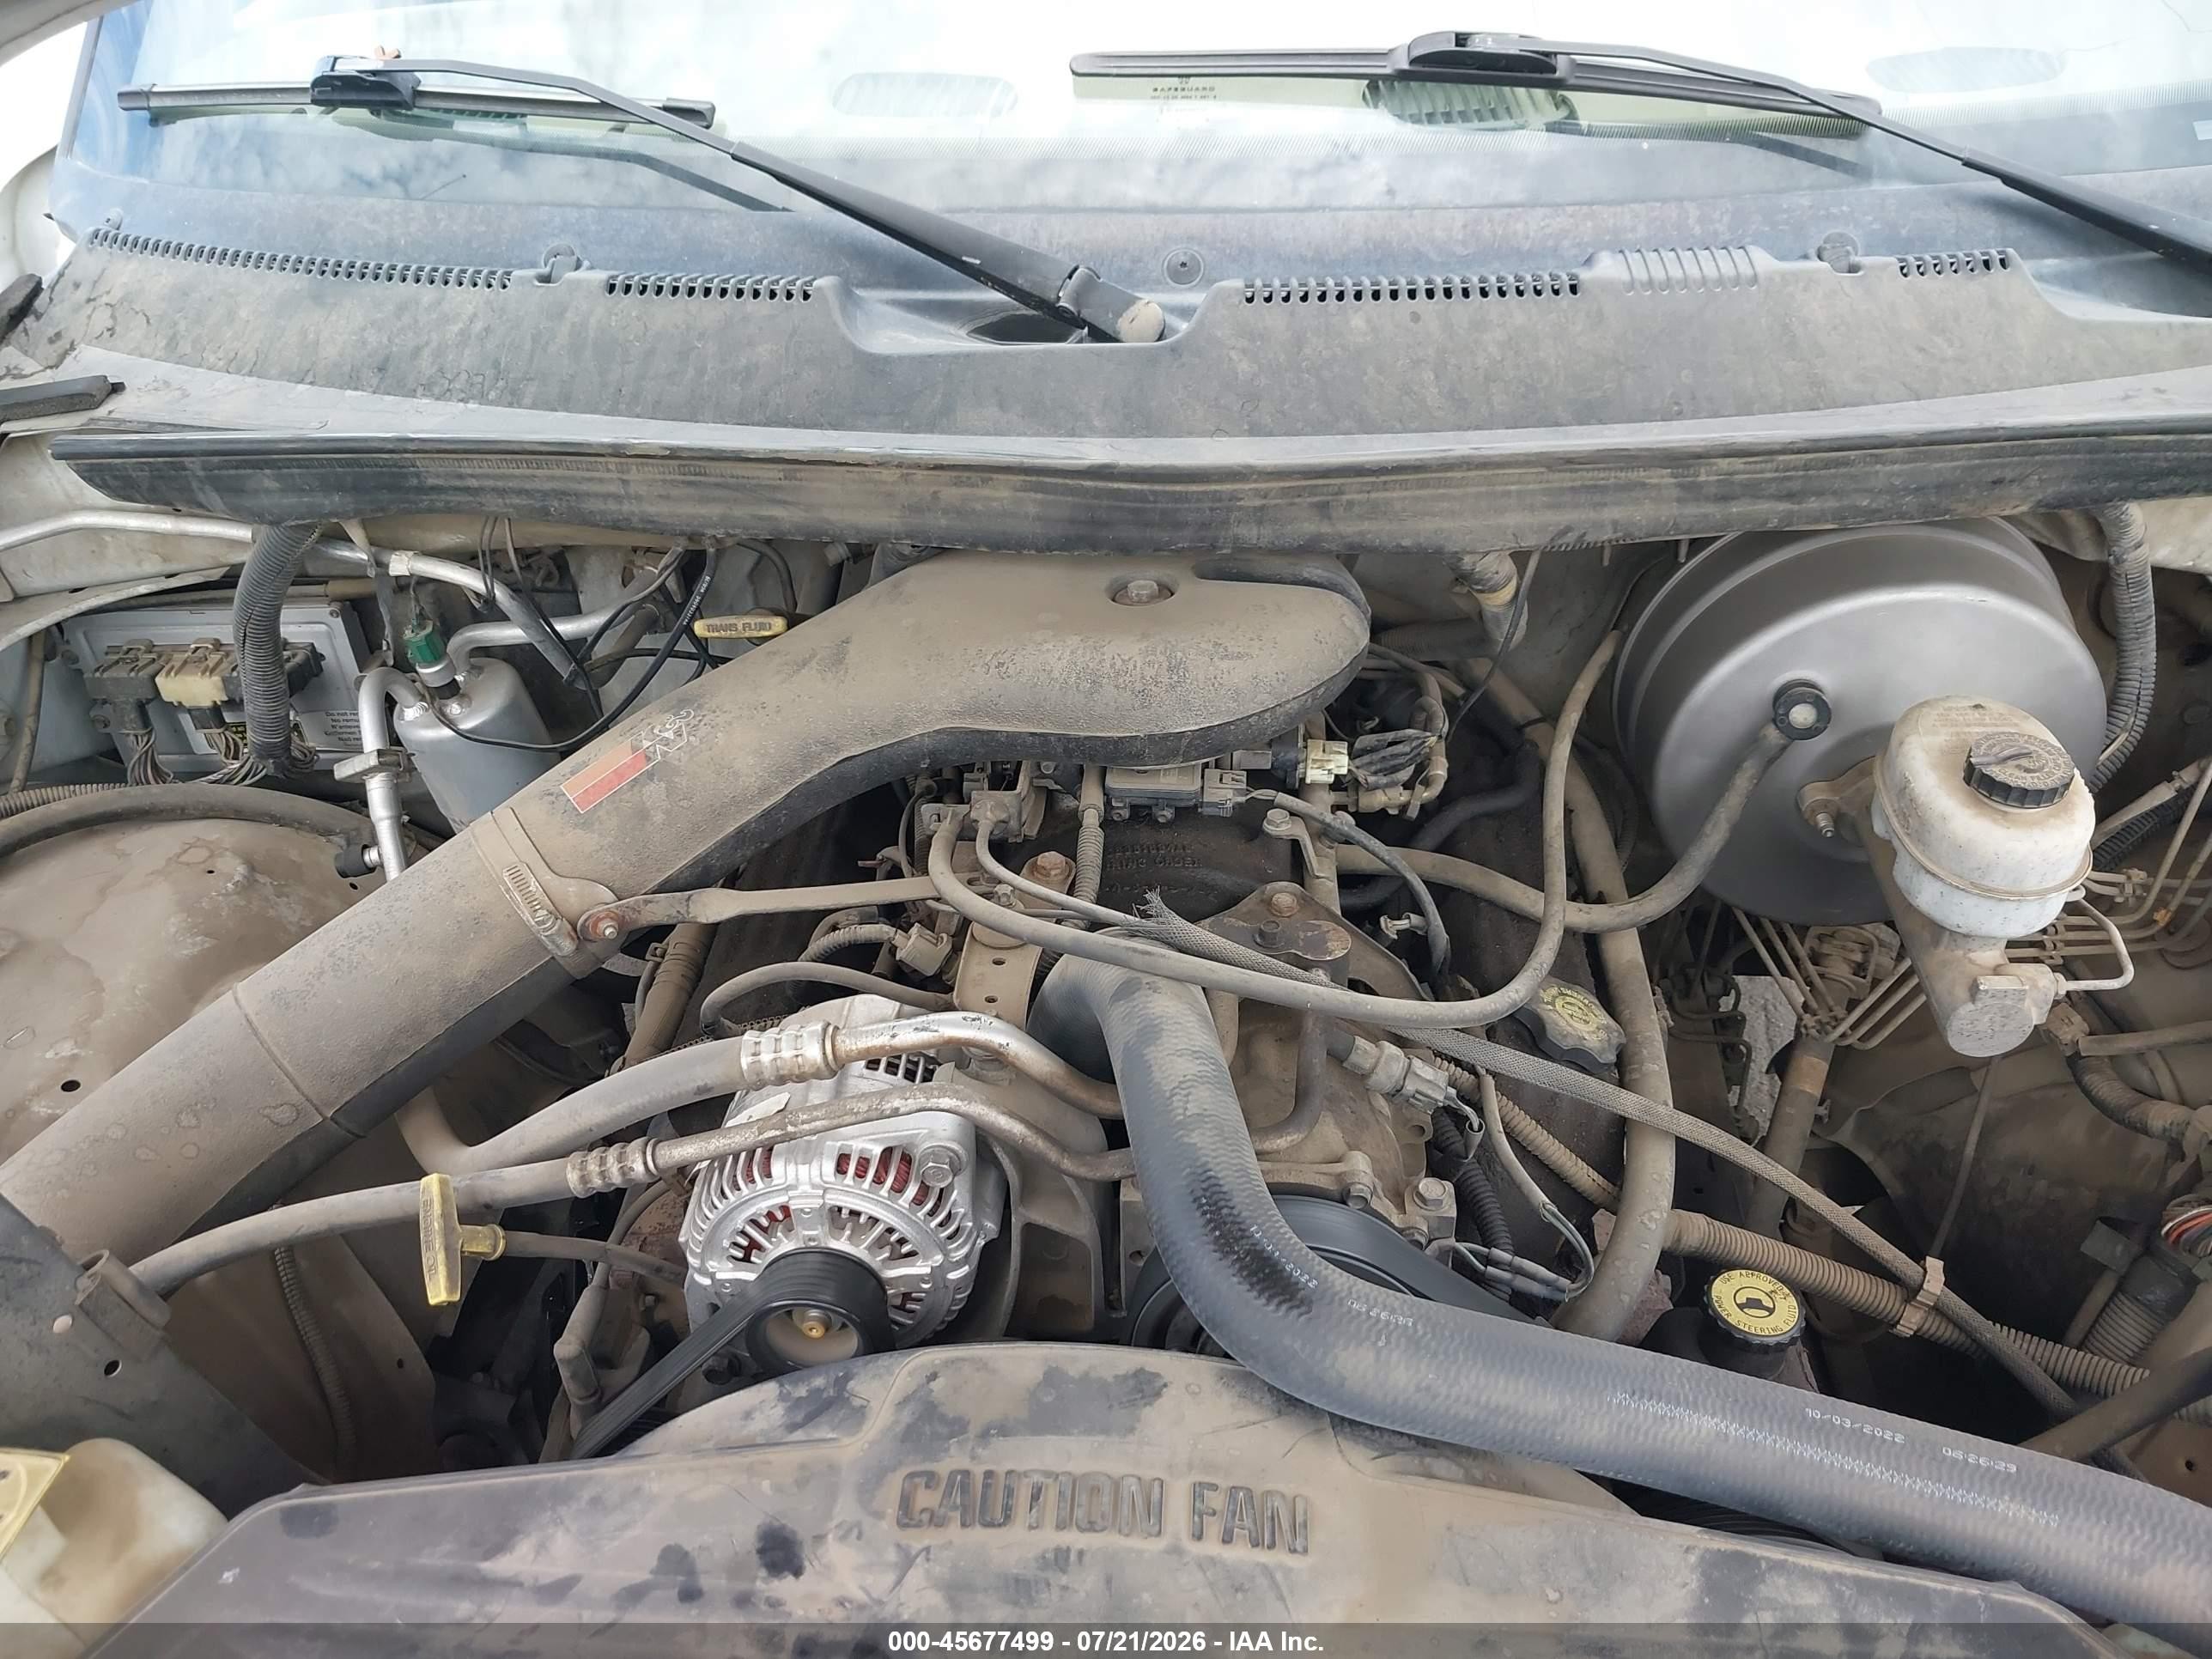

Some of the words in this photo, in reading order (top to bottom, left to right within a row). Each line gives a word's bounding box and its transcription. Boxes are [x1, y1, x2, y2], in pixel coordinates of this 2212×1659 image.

[707, 623, 738, 633] TRANS
[741, 622, 771, 632] FLUID
[1719, 1273, 1735, 1285] USE
[1739, 1271, 1784, 1294] APPROVED
[1714, 1295, 1732, 1319] POWER
[1735, 1319, 1784, 1334] STEERING
[1783, 1304, 1797, 1327] FLUID
[896, 1469, 1164, 1540] CAUTION
[1190, 1480, 1310, 1554] FAN
